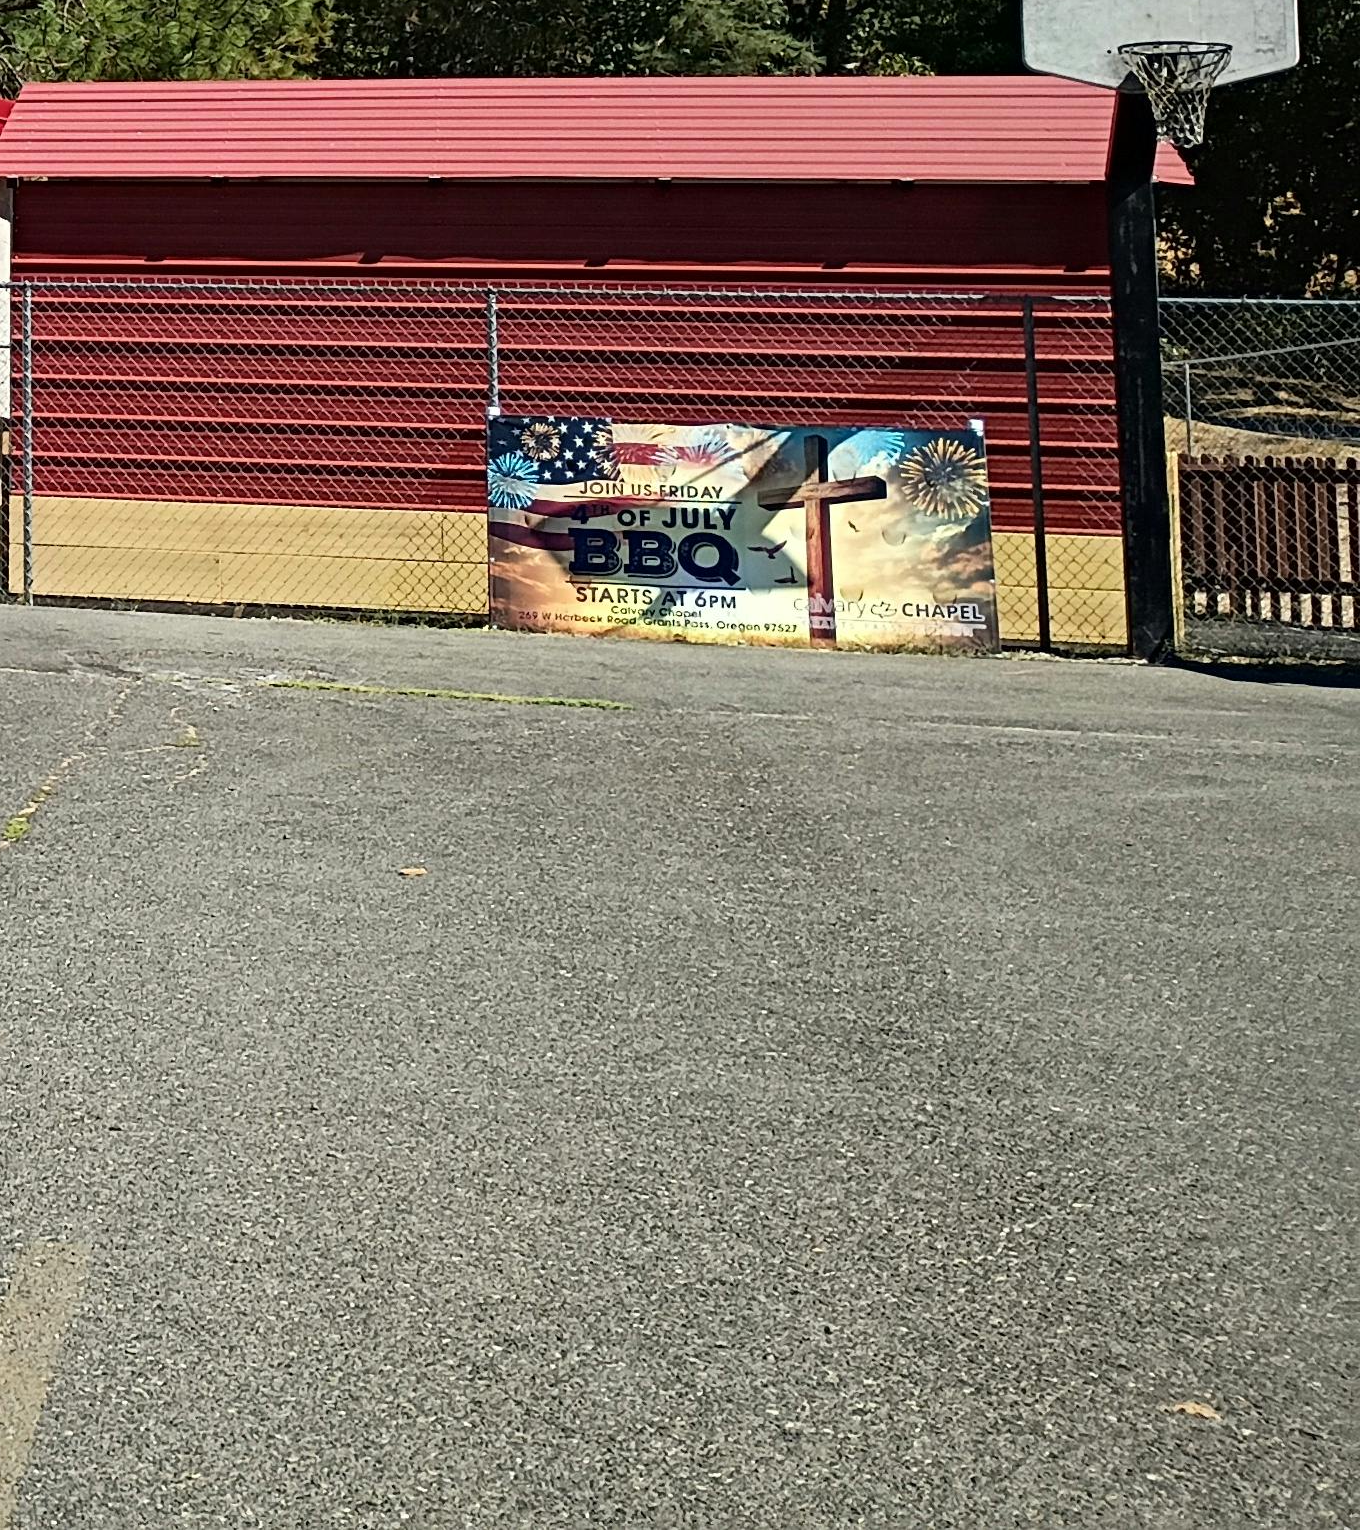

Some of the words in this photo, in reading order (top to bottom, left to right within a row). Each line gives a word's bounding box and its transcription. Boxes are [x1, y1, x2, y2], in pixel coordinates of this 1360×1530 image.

[579, 481, 624, 495] JOIN
[659, 484, 724, 499] FRIDAY
[569, 503, 610, 525] 4TH
[616, 509, 651, 527] OF
[661, 507, 737, 531] JULY
[567, 527, 742, 587] BBQ
[575, 586, 654, 605] STARTS
[661, 590, 688, 607] AT
[694, 590, 737, 609] 6PM
[518, 611, 538, 620] 269
[542, 612, 552, 621] W
[643, 618, 681, 627] Grants
[716, 620, 761, 632] Oregon
[611, 605, 655, 618] Calvary
[659, 607, 702, 619] Chapel
[902, 602, 985, 621] CHAPEL
